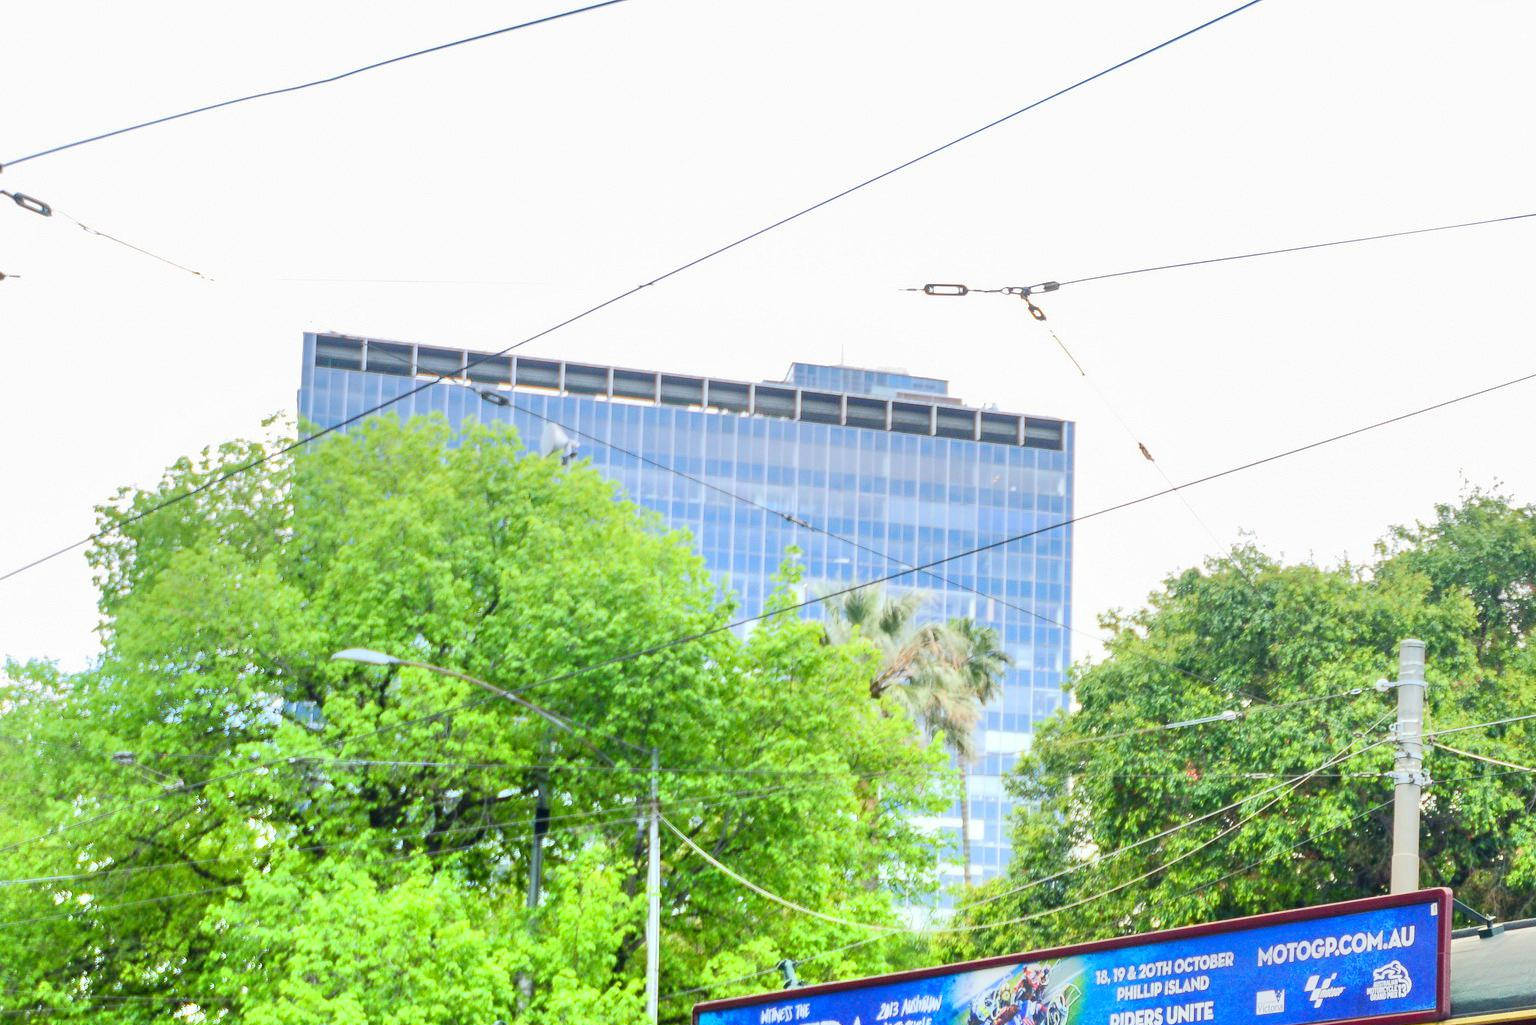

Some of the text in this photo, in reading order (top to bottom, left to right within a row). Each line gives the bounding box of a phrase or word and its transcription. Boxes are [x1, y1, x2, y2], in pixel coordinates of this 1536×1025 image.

[1257, 925, 1416, 967] MOTOGP.COM.AU
[1095, 952, 1235, 986] 18, 19 & 20TH OCTOBER
[1116, 975, 1210, 1001] PHILLIP ISLAND
[795, 1003, 810, 1019] THE
[876, 1002, 899, 1021] 2013
[1166, 1001, 1214, 1024] UNITE
